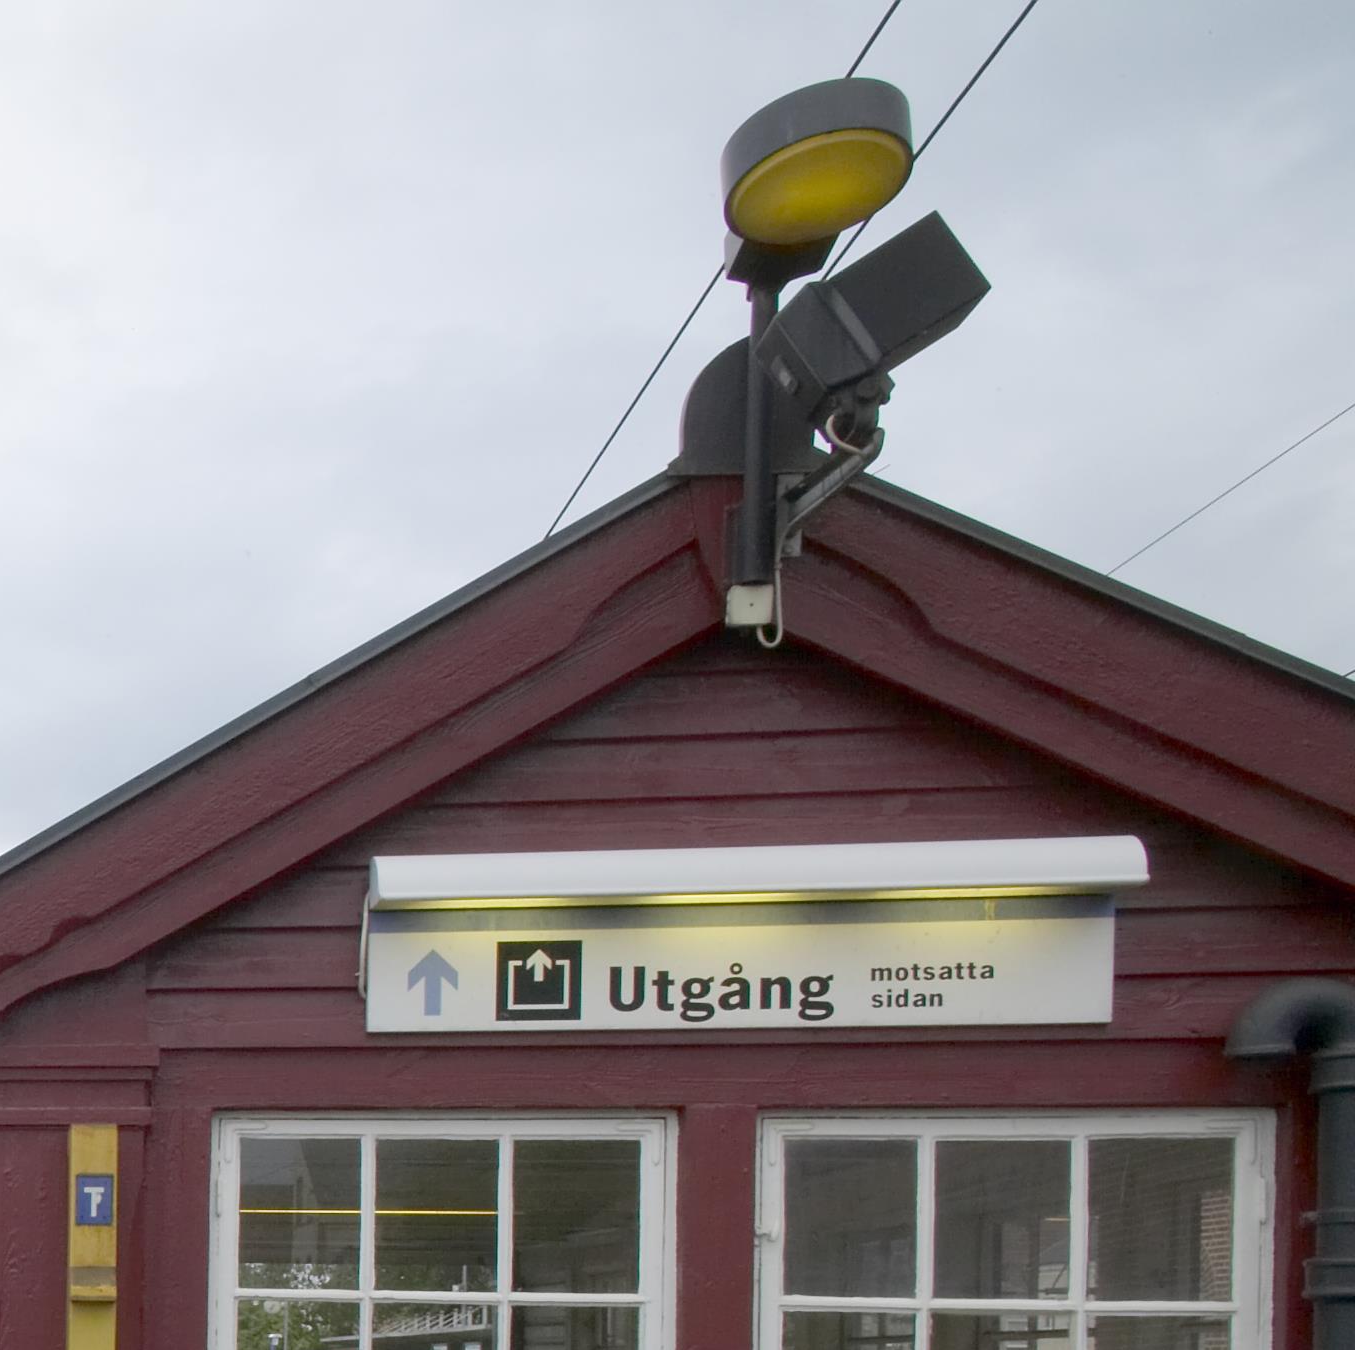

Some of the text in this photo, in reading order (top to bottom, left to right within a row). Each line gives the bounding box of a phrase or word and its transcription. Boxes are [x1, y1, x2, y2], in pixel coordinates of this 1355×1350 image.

[870, 962, 995, 982] motsatta
[609, 962, 835, 1022] Utgång
[871, 988, 944, 1008] sidan
